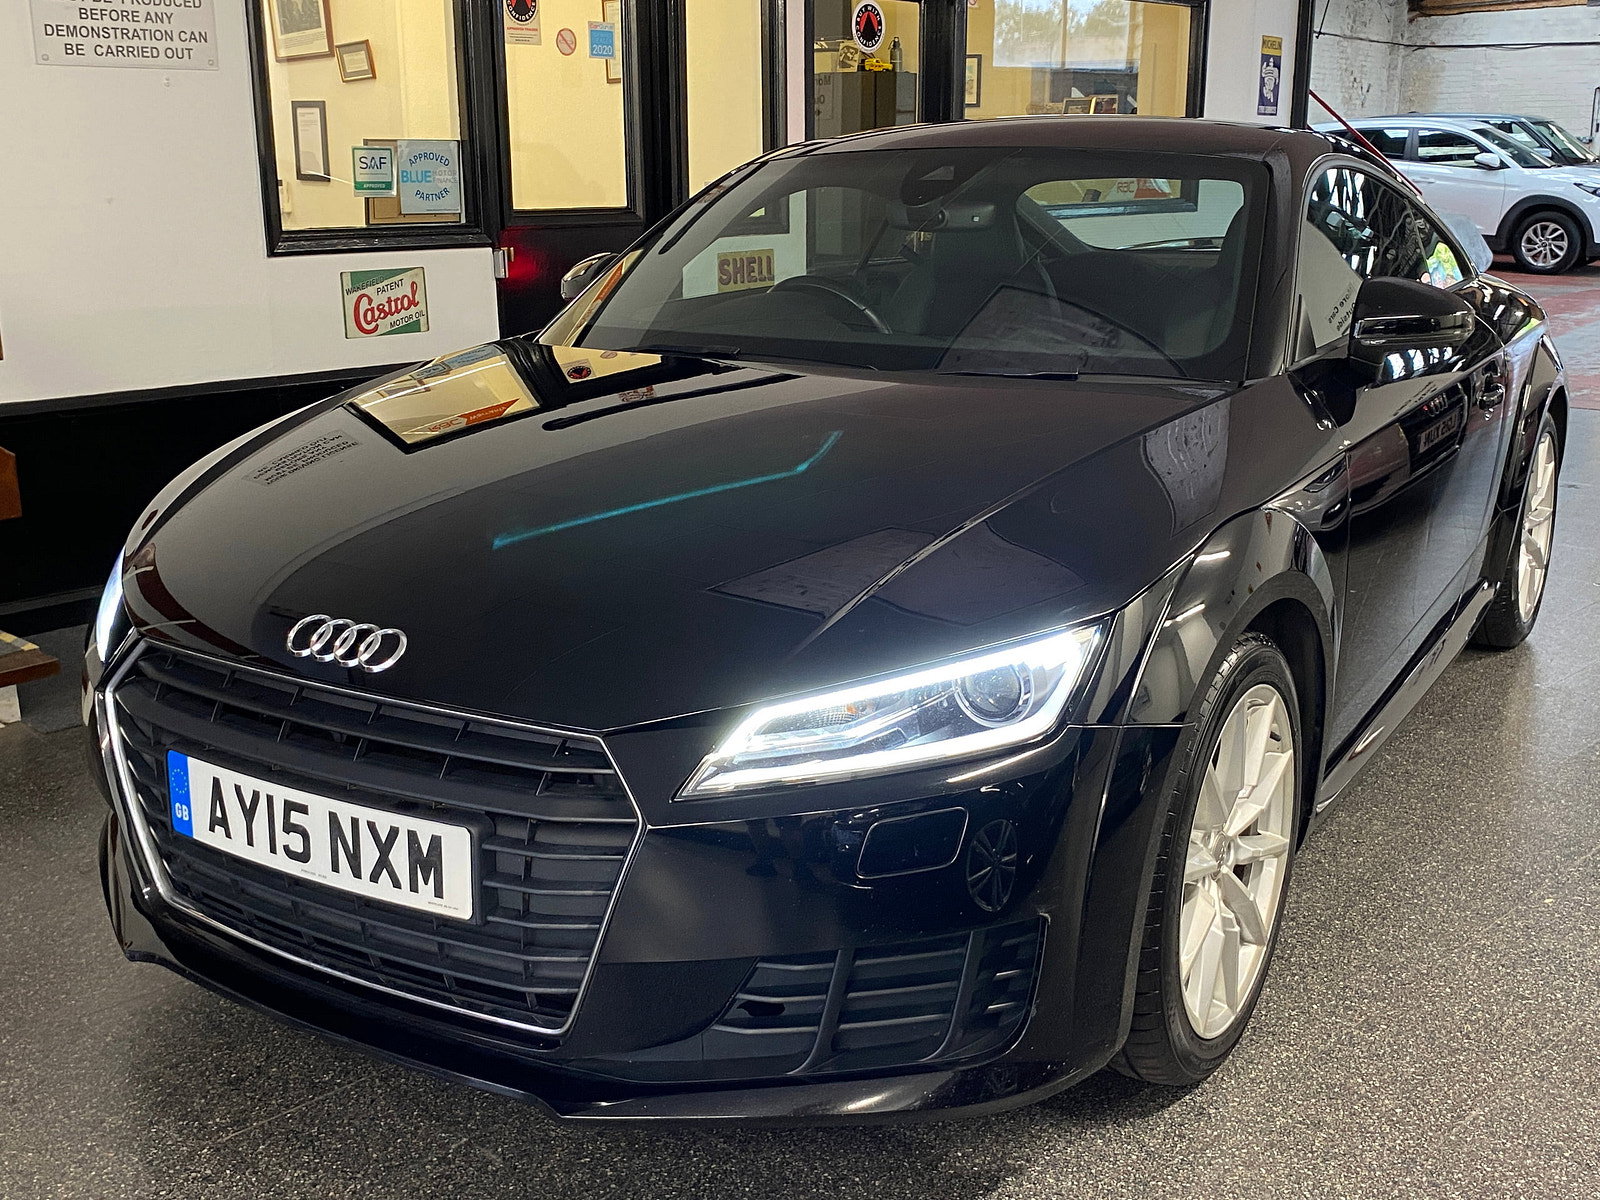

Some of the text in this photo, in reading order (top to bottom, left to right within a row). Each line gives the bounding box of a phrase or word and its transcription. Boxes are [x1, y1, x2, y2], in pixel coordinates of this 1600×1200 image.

[79, 8, 174, 24] BEFORE ANY
[867, 5, 881, 21] WITH
[44, 24, 208, 43] DEMONSTRATION CAN
[855, 25, 882, 47] CONFIDENCE
[64, 43, 194, 60] BE CARRIED OUT
[592, 44, 613, 55] 2020
[359, 156, 387, 170] SAF
[408, 151, 450, 167] APPROVED
[400, 169, 432, 184] BLUE
[415, 187, 450, 201] PARTNER
[718, 256, 775, 286] SHELL
[345, 276, 385, 296] WAKEFIELD
[376, 278, 404, 296] PATENT
[353, 280, 420, 335] Castrol
[389, 310, 426, 329] MOTOR OIL
[175, 802, 190, 821] GB
[209, 776, 444, 899] AY15 NXM
